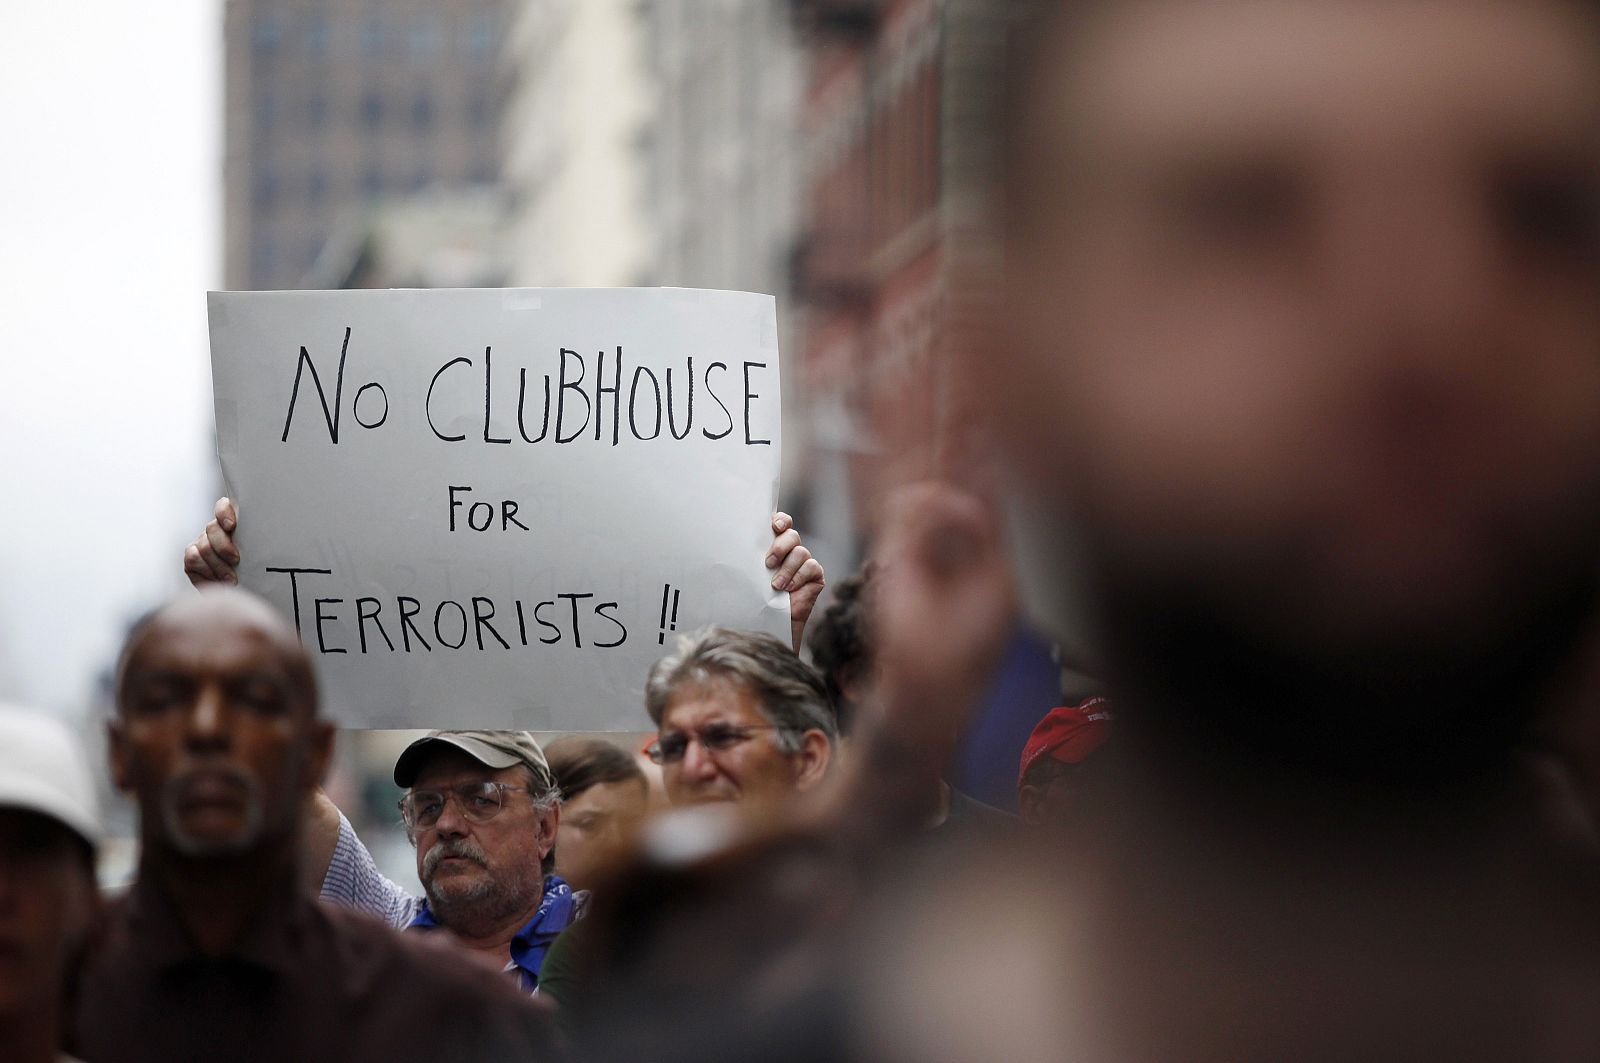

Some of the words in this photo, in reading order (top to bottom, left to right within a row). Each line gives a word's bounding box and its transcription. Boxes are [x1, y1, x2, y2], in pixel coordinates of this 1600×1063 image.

[281, 326, 389, 445] No
[425, 345, 771, 446] CLUBHOUSE
[448, 485, 530, 533] FOR
[265, 567, 628, 654] TERRORISTS
[658, 583, 681, 646] !!
